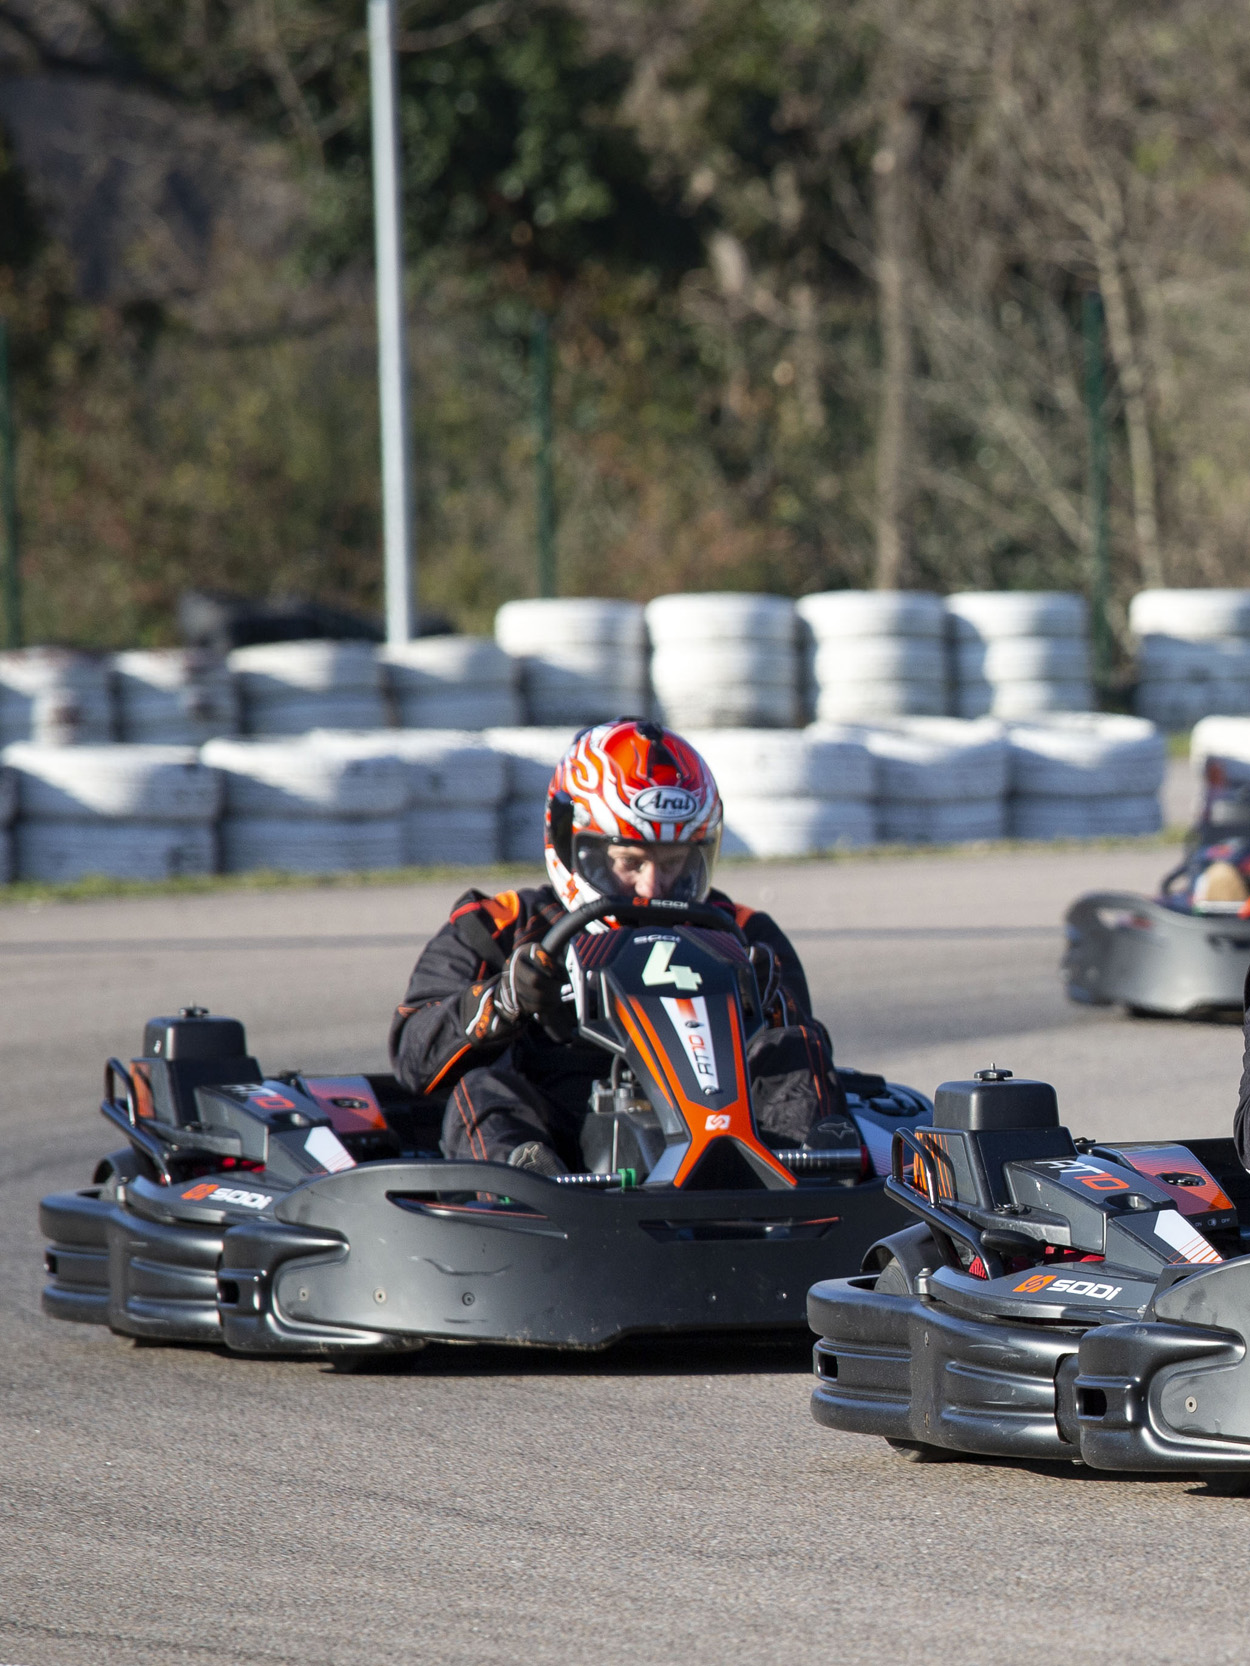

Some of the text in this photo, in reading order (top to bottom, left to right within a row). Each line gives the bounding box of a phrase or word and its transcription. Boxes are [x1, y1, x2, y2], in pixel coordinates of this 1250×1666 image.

[641, 790, 690, 810] Arai
[650, 899, 689, 910] SODI
[641, 940, 703, 991] 4
[209, 1187, 273, 1211] SODI
[1046, 1278, 1123, 1301] SODI
